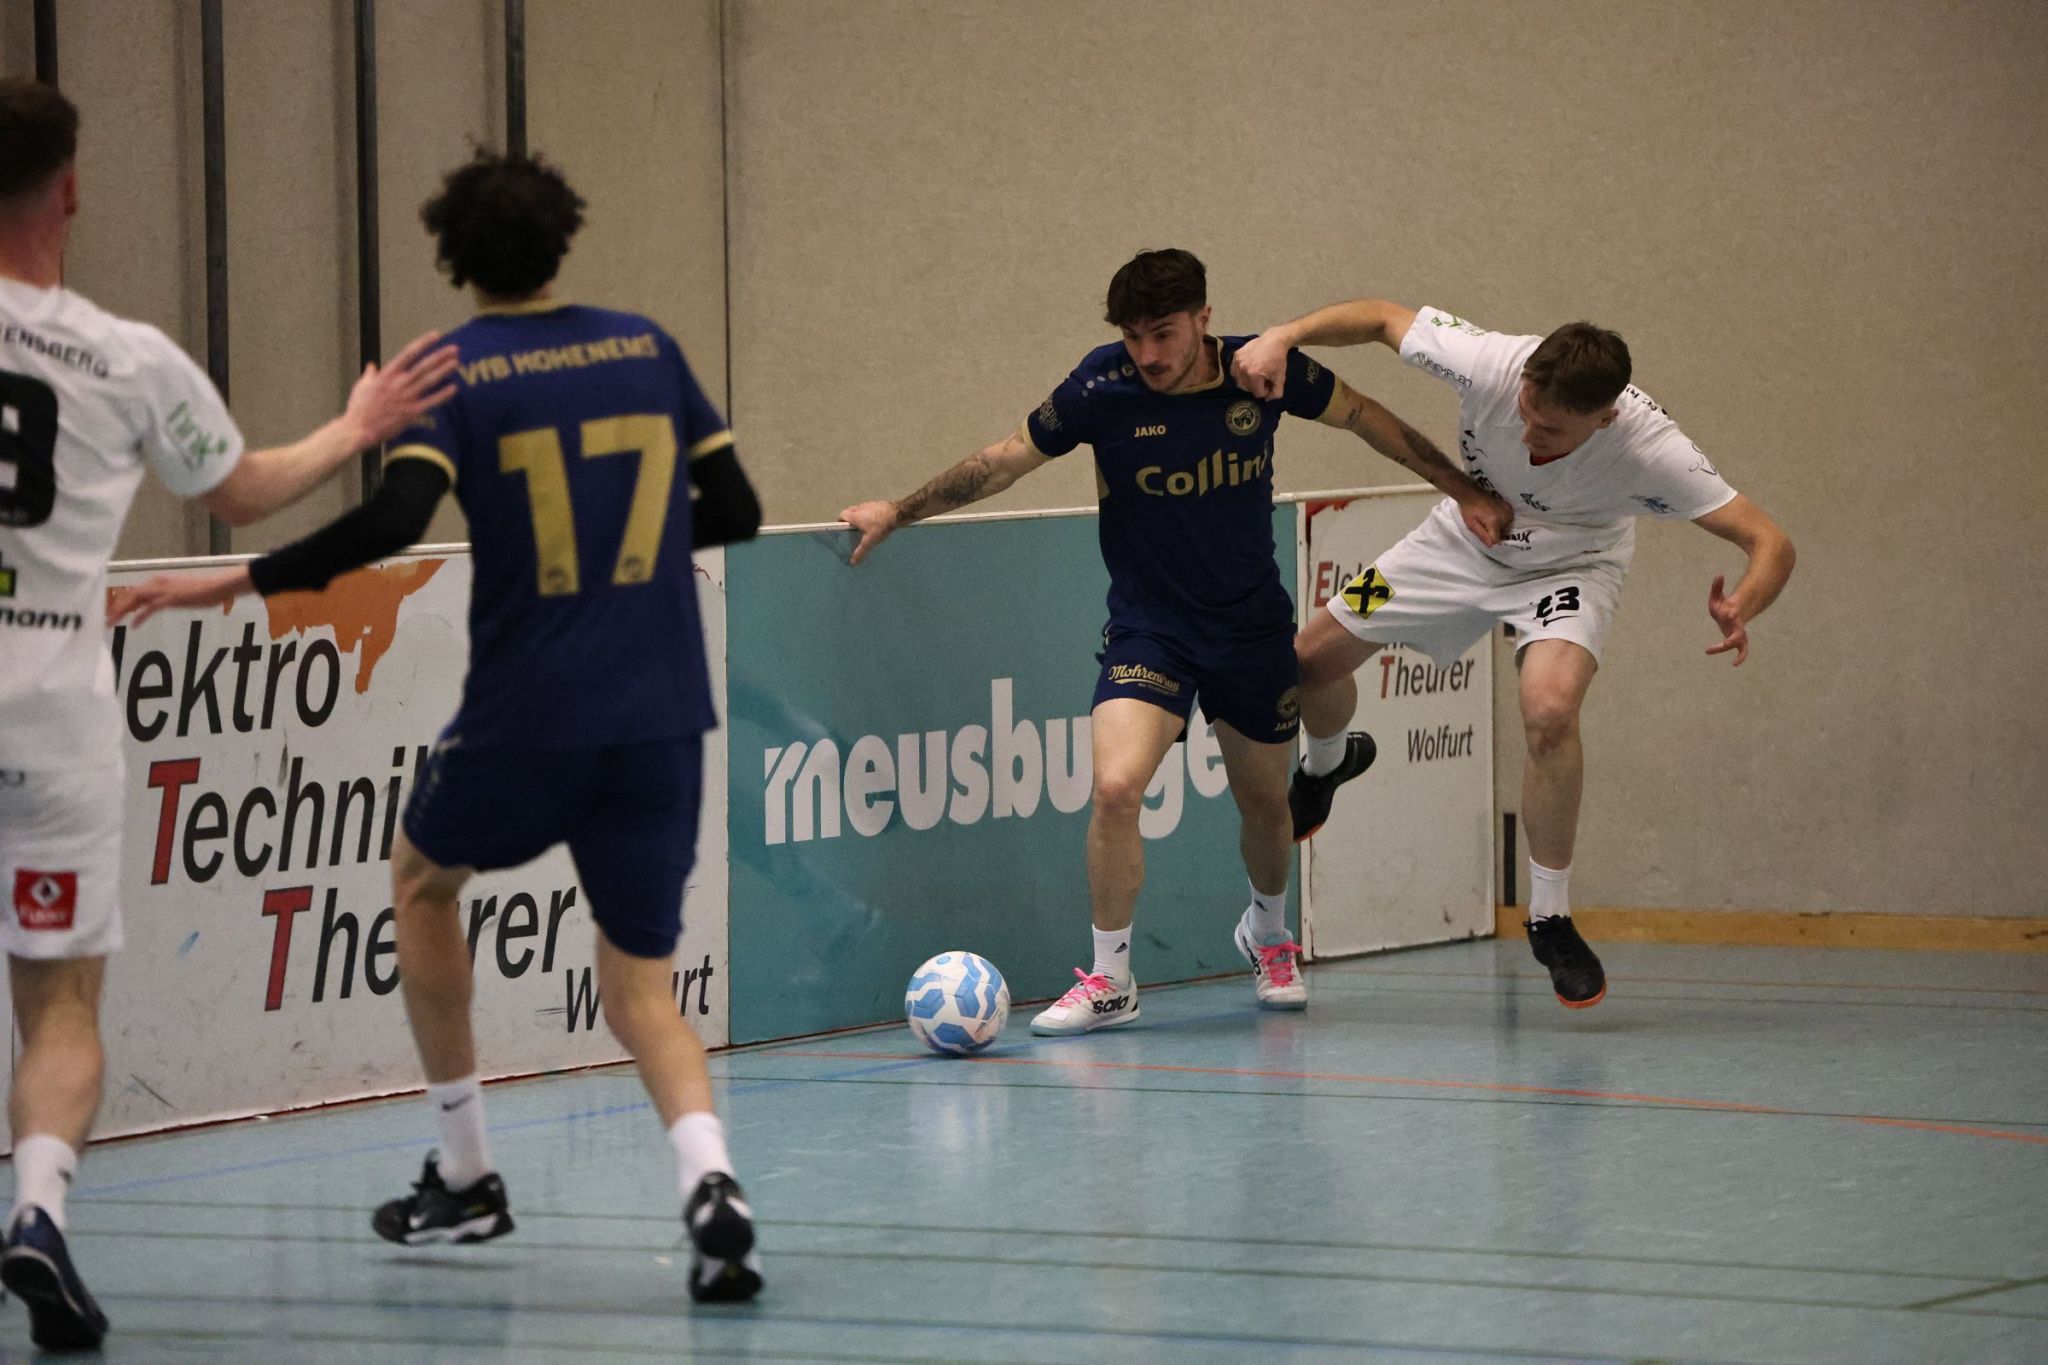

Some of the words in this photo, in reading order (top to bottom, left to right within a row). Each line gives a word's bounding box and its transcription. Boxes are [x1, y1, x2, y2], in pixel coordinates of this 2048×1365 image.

[0, 321, 109, 378] ENSBERG
[1134, 425, 1167, 438] JAKO
[498, 413, 677, 598] 17
[111, 620, 341, 743] lektro
[1380, 655, 1474, 699] Theurer
[764, 677, 1230, 846] meusbuge
[1408, 723, 1473, 763] Wolfurt
[148, 745, 428, 886] Techni
[262, 885, 577, 1012] Therer
